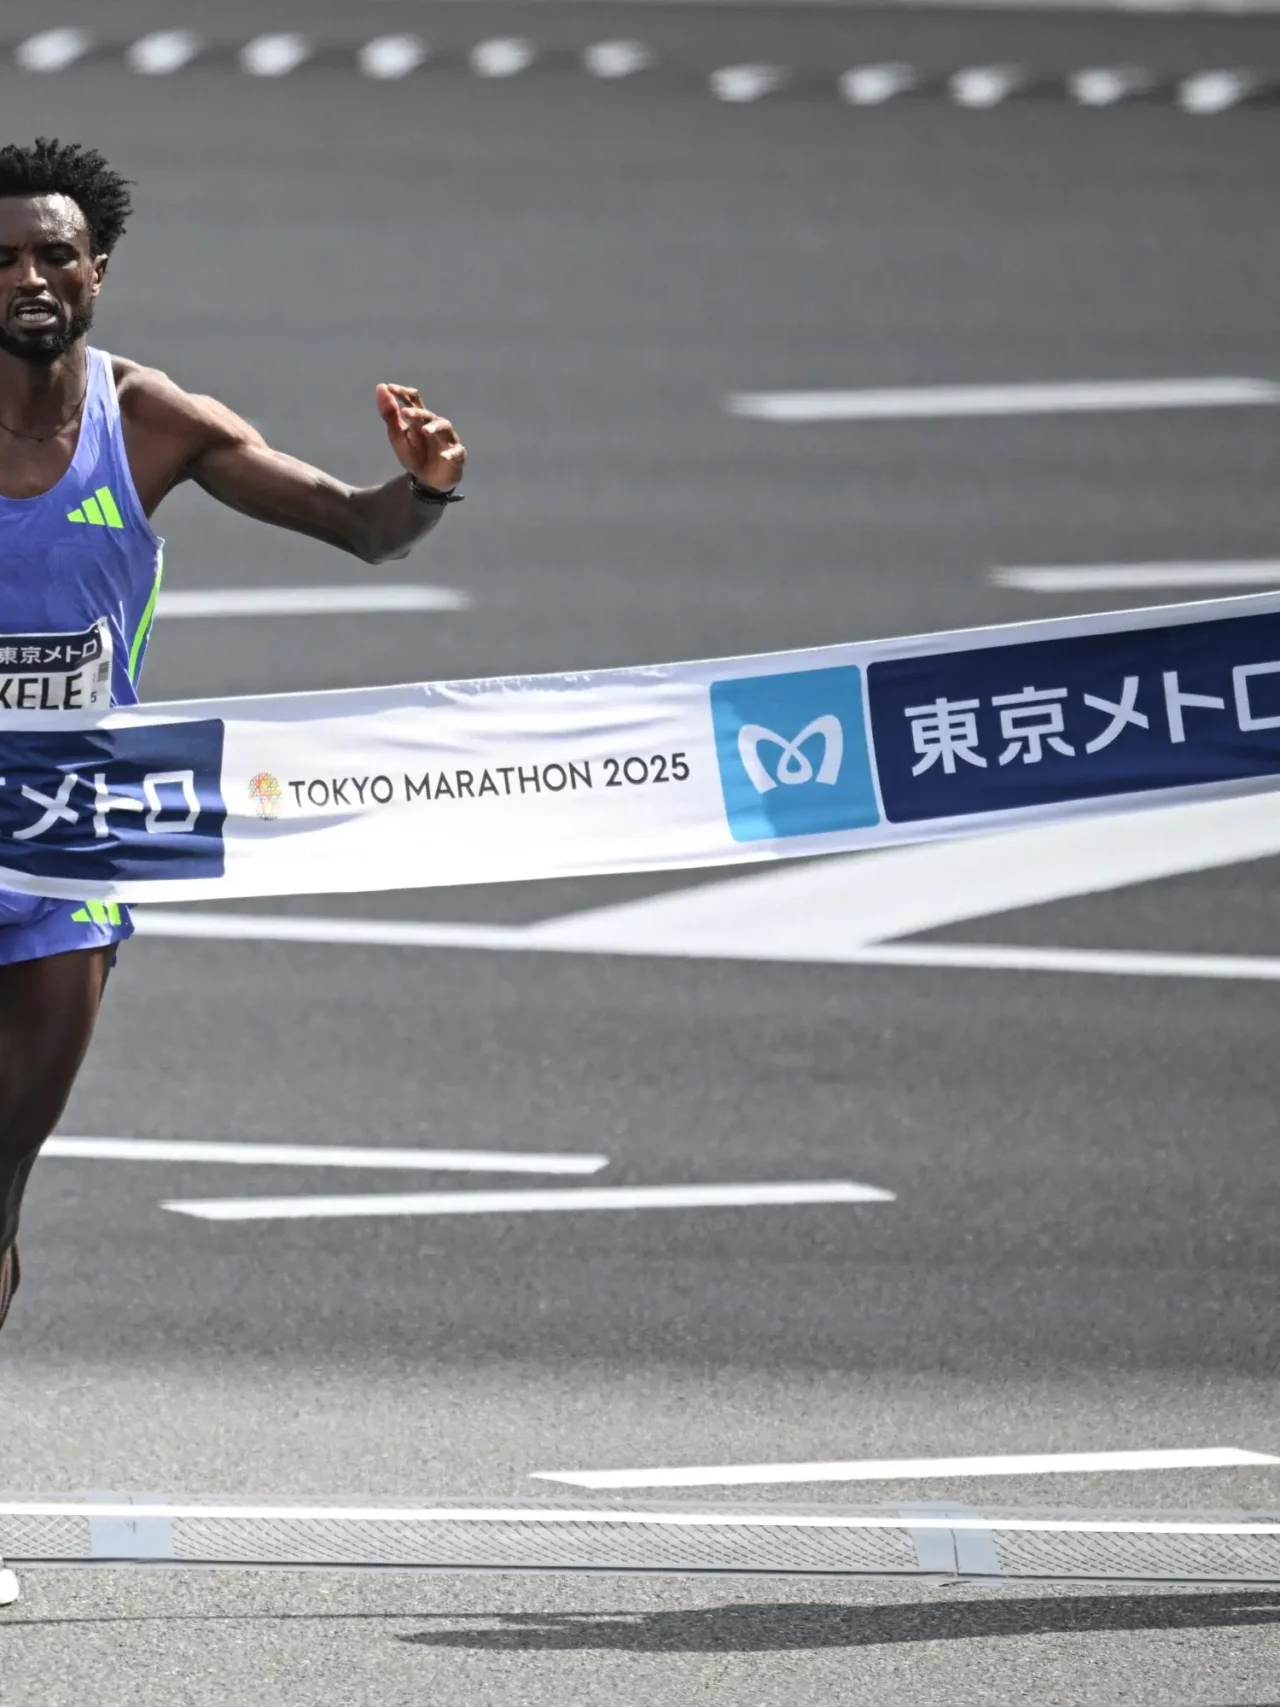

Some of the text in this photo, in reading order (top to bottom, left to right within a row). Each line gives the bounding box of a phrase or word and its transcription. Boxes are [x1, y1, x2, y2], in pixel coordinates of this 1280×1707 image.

[90, 690, 97, 703] 5
[904, 660, 1280, 776] 東京メトロ
[288, 752, 691, 808] TOKYO MARATHON 2025
